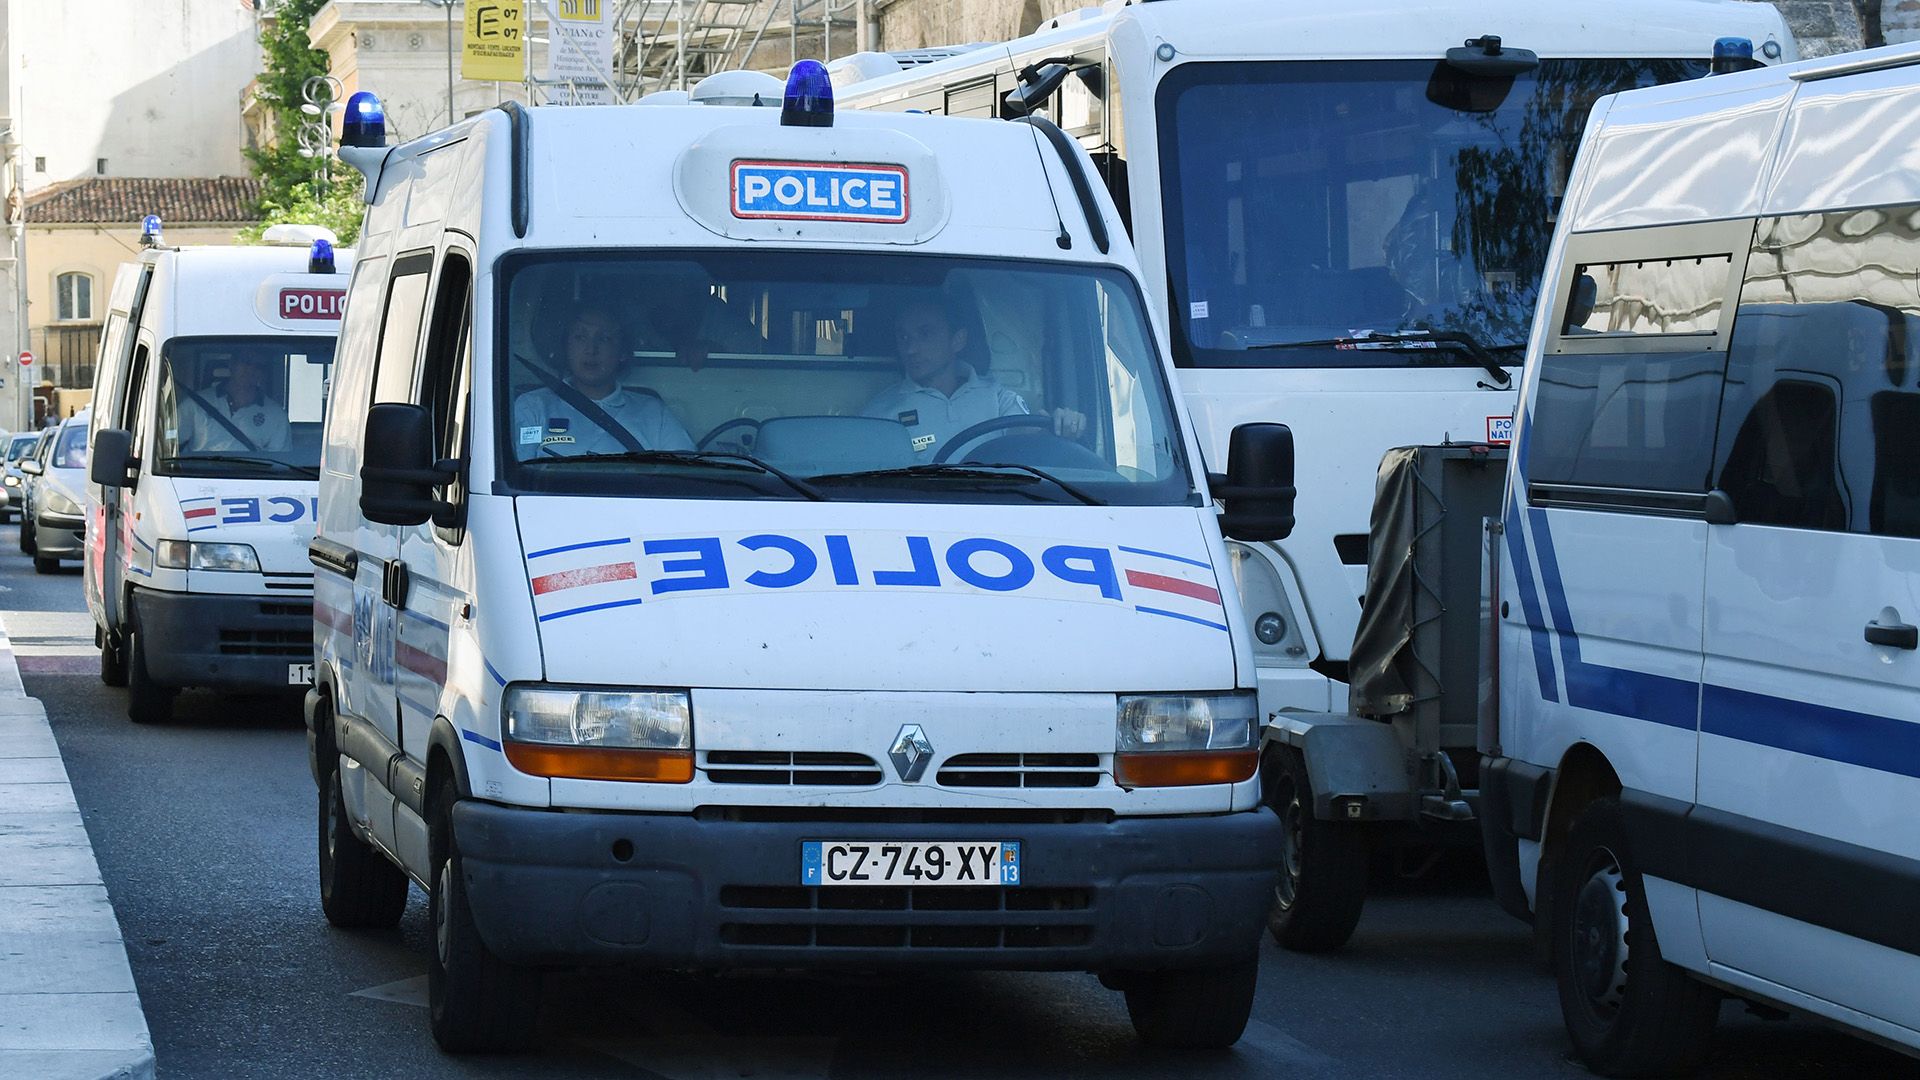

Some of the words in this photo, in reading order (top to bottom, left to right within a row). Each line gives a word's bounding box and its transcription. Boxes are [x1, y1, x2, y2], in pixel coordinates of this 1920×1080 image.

[503, 9, 518, 21] 07
[503, 28, 518, 40] 07
[743, 175, 896, 209] POLICE
[285, 295, 347, 314] POLIC
[912, 436, 933, 444] LICE
[826, 845, 997, 881] CZ-749-XY
[807, 867, 815, 878] F
[1001, 865, 1018, 882] 13
